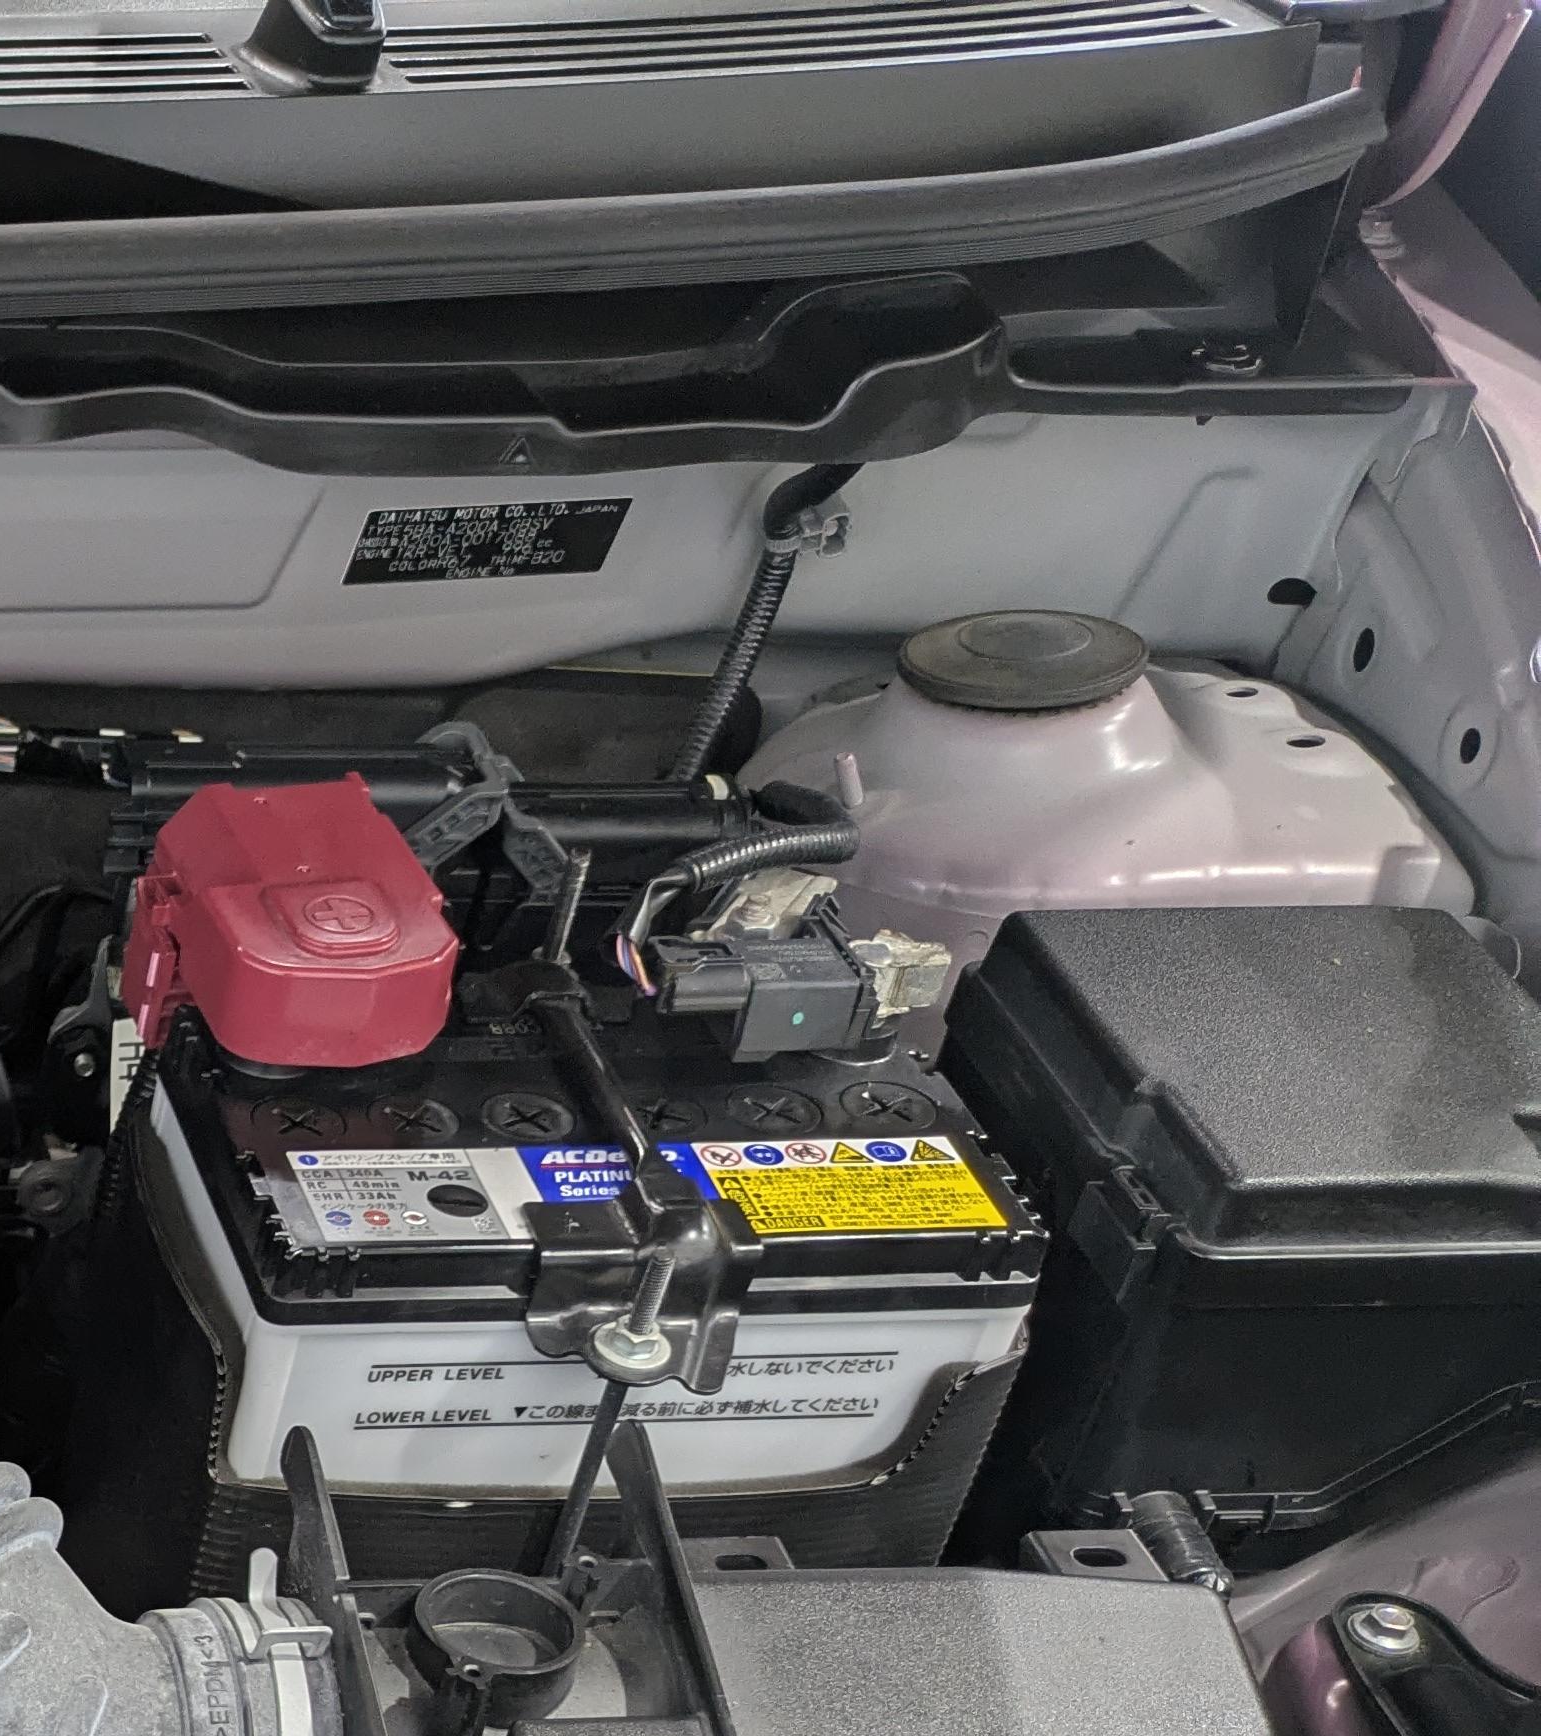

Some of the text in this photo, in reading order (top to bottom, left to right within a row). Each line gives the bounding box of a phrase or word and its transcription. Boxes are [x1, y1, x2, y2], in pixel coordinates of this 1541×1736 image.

[378, 511, 446, 525] DAIHATSU
[454, 506, 499, 520] MOTOR
[541, 1150, 677, 1164] ACDeo
[301, 1169, 334, 1179] CCA
[406, 1170, 472, 1182] M-42
[560, 1184, 620, 1197] Series
[765, 1217, 822, 1228] DANGER
[726, 1358, 894, 1377] 水しないでください
[367, 1367, 505, 1384] UPPER LEVEL
[528, 1396, 880, 1420] この線ま減る前に必ず補水してください
[355, 1408, 492, 1425] LOWER LEVEL
